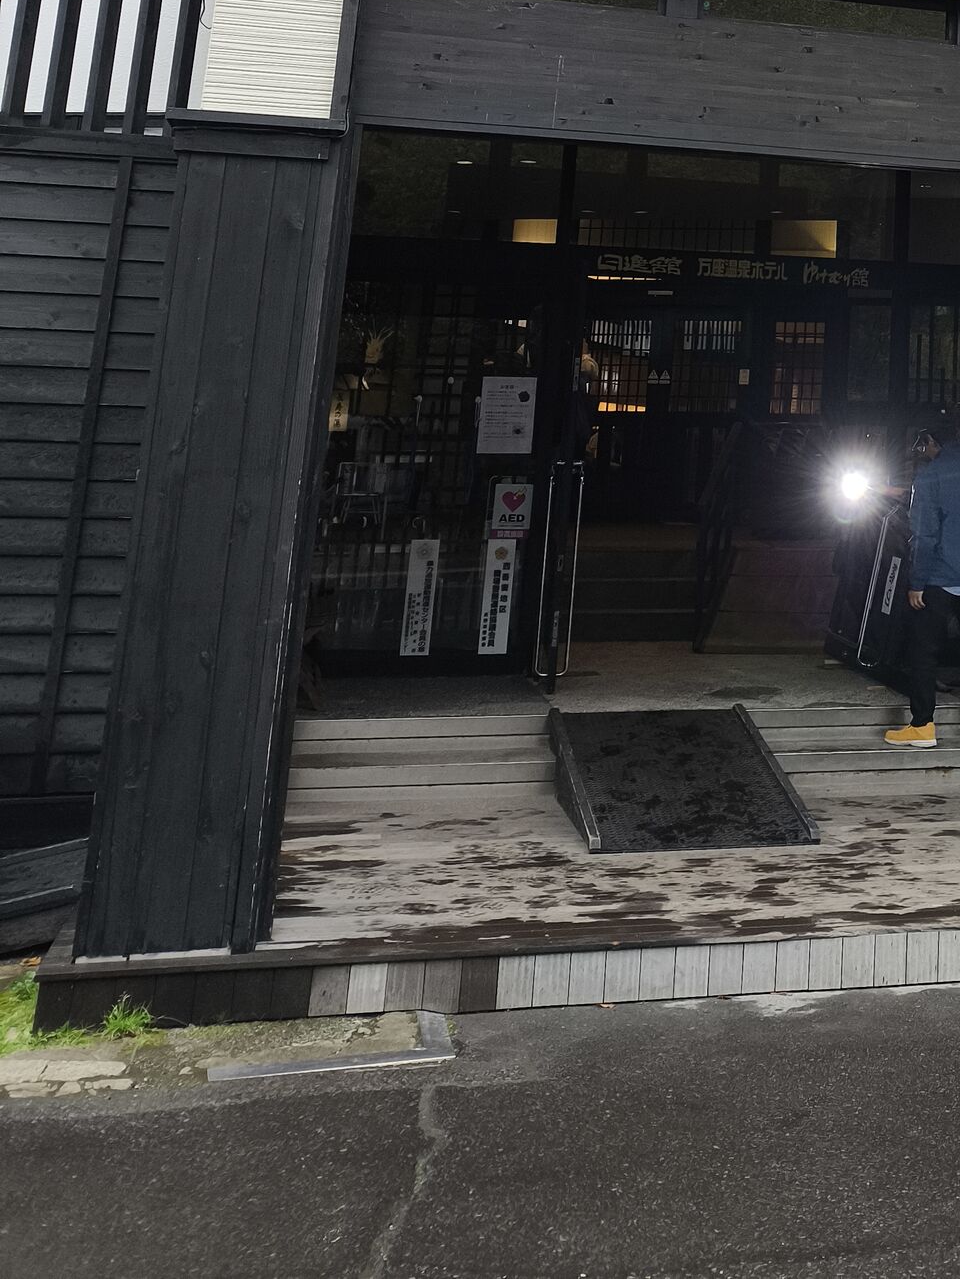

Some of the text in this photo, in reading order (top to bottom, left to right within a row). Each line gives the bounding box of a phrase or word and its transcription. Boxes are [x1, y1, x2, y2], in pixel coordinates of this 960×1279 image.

[696, 257, 789, 281] 万座温泉ホテル
[498, 513, 526, 523] AED
